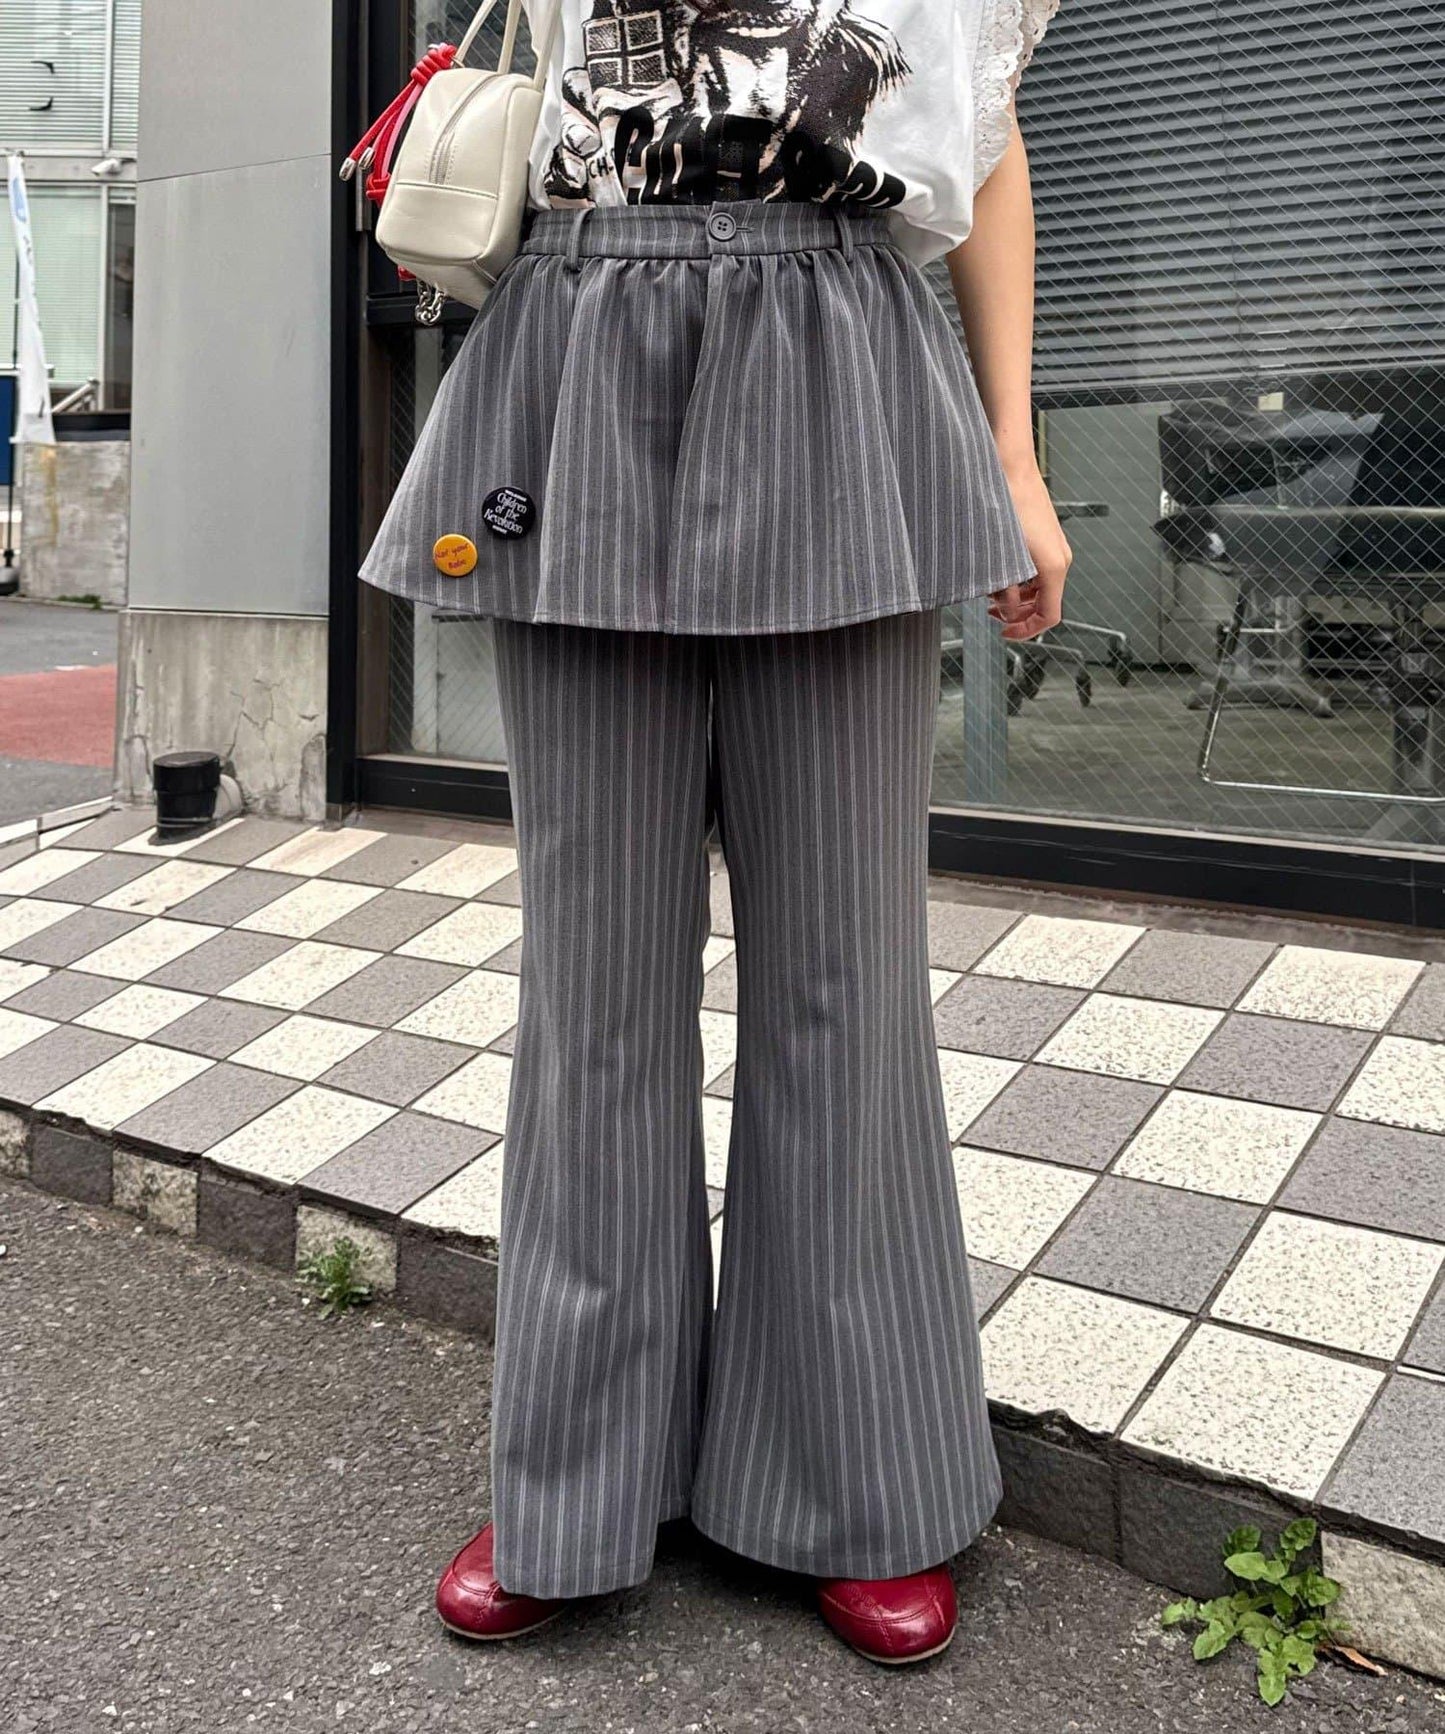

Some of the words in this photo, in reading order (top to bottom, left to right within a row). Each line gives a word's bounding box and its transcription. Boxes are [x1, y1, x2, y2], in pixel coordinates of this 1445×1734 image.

[495, 504, 505, 514] of
[497, 492, 527, 514] Children
[483, 508, 523, 534] Revolution
[451, 542, 468, 557] your
